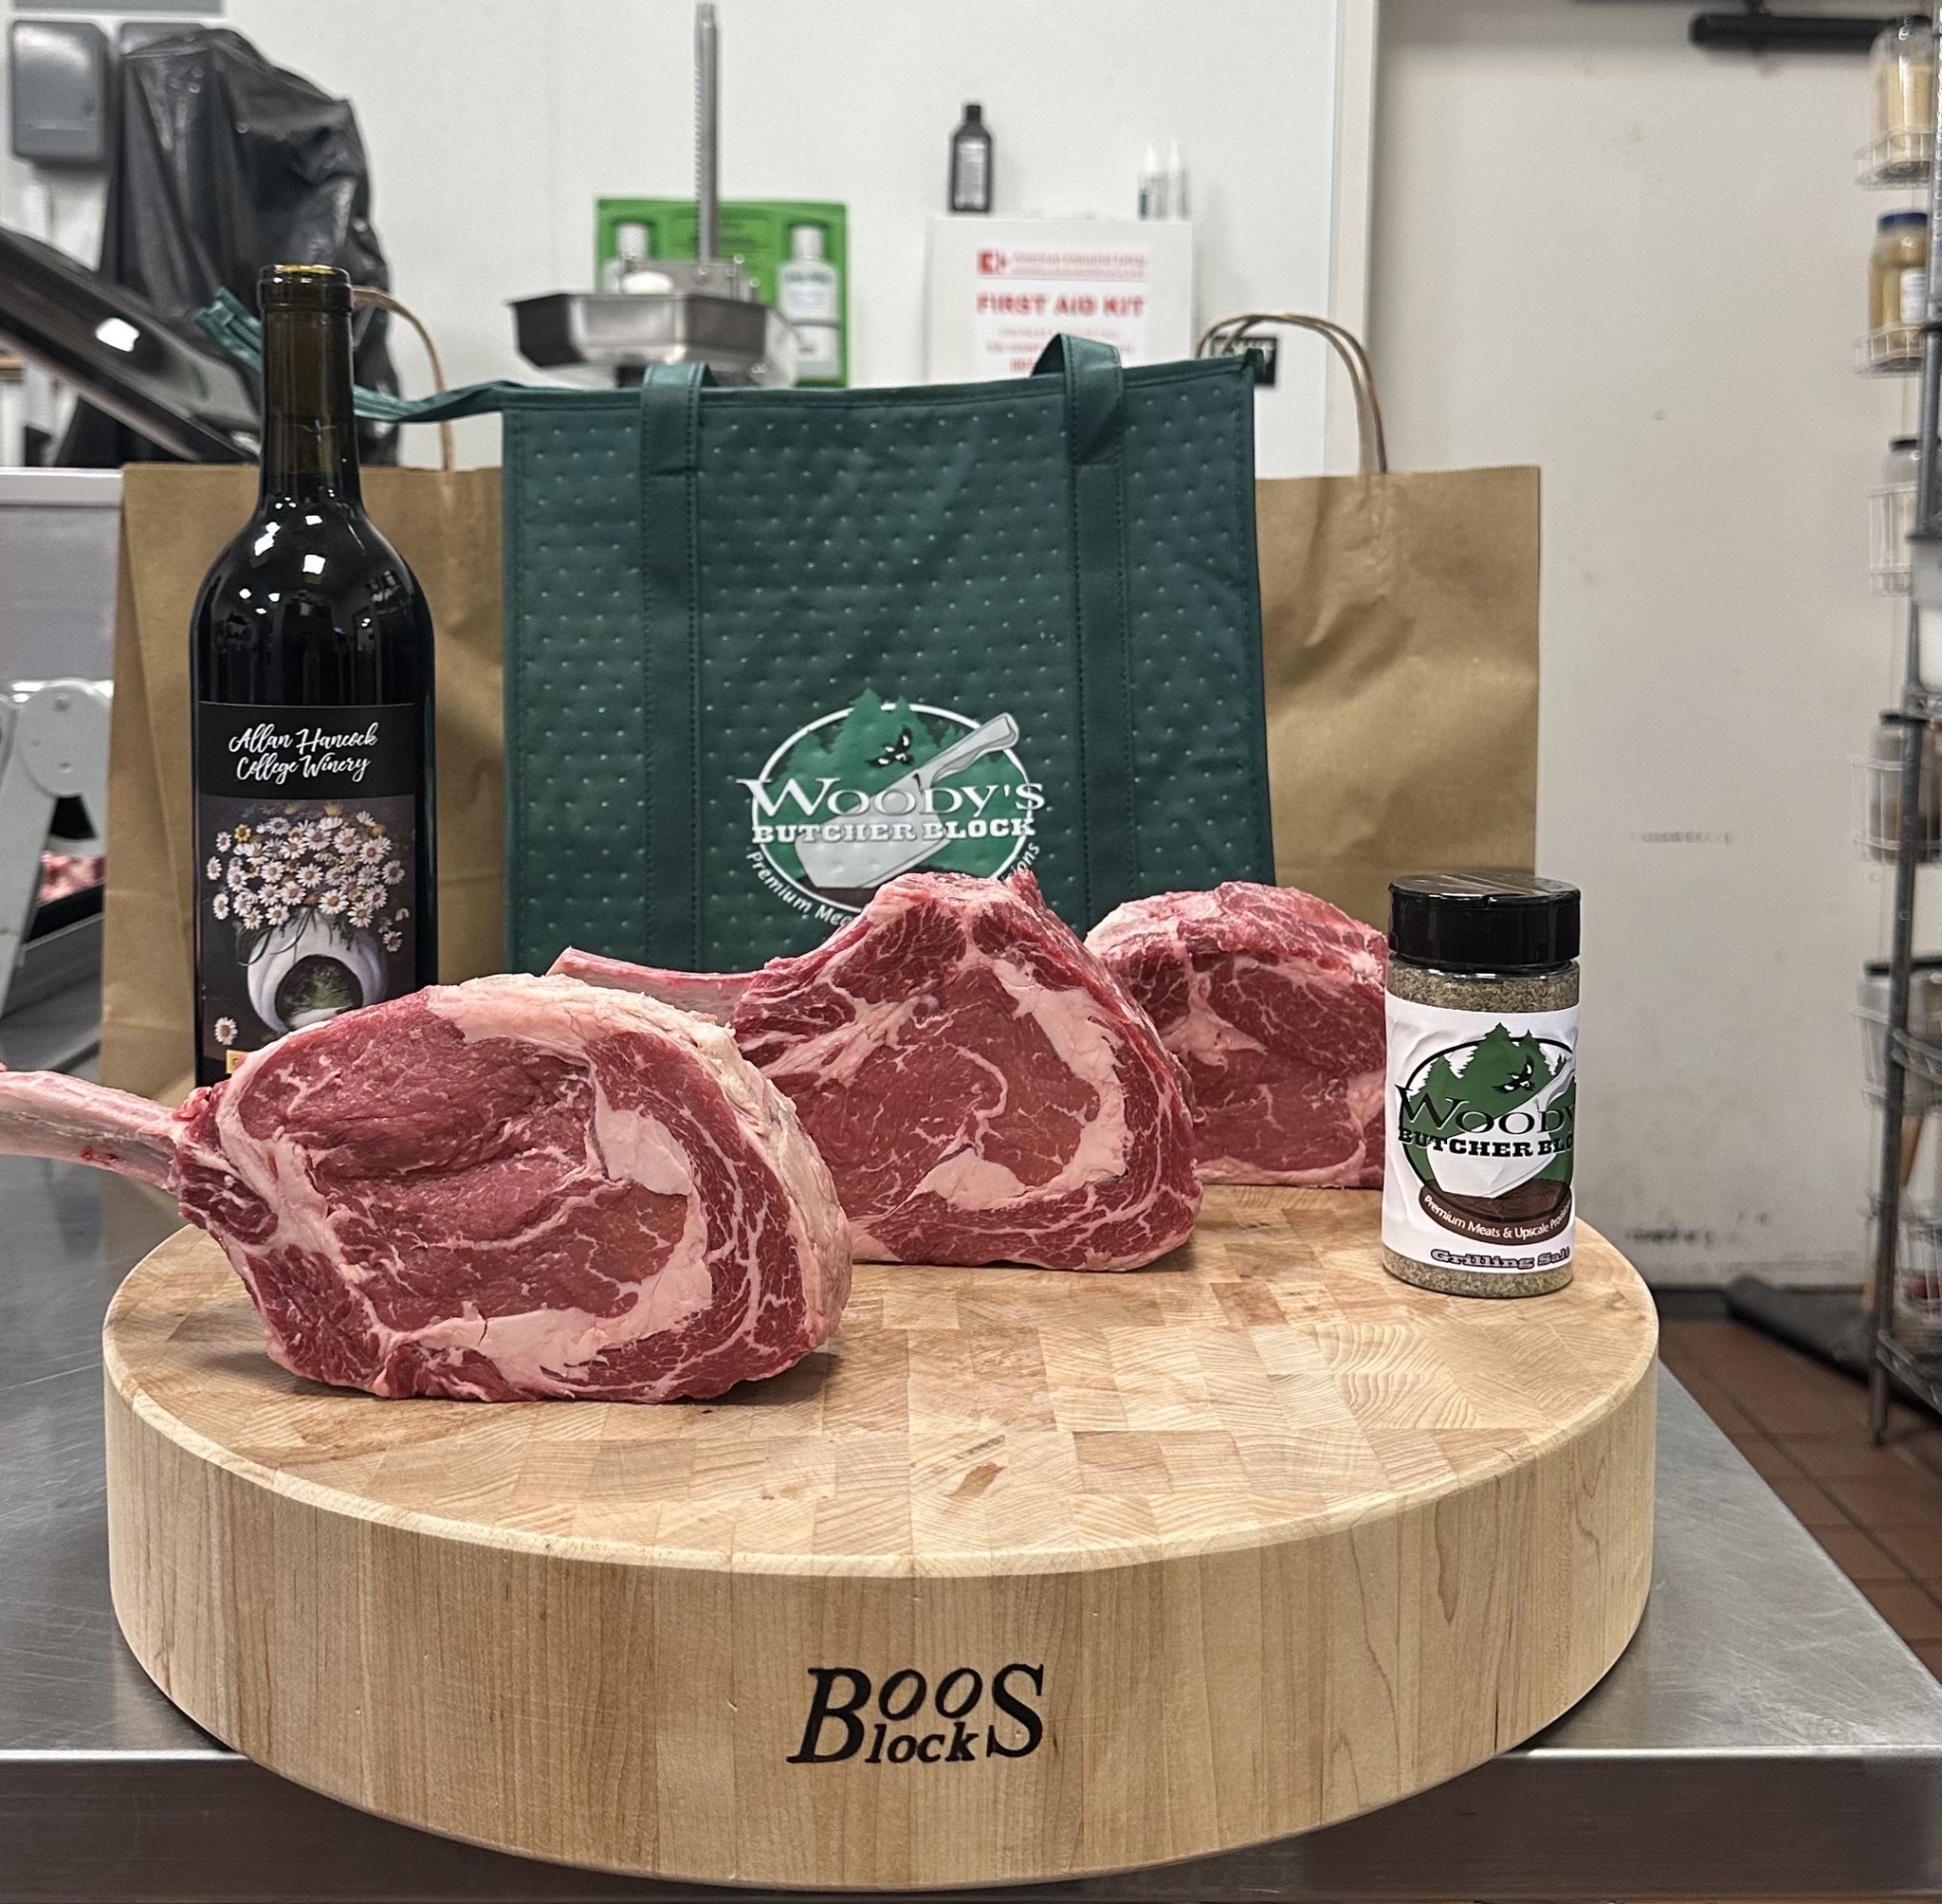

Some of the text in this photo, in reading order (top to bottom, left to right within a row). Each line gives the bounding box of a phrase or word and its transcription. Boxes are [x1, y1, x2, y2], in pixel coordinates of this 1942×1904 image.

[977, 294, 1145, 317] FIRST AID KIT
[229, 722, 378, 755] Allan Hancock
[237, 752, 372, 785] College Winery
[752, 818, 1035, 844] BUTCHER BLOCK
[745, 851, 813, 913] Premium
[1398, 1126, 1533, 1158] BUTCHER
[1424, 1194, 1466, 1230] Premium
[1467, 1220, 1501, 1238] Meats
[1502, 1226, 1512, 1238] &
[1514, 1223, 1549, 1240] Upscale
[1430, 1248, 1535, 1270] Grilling
